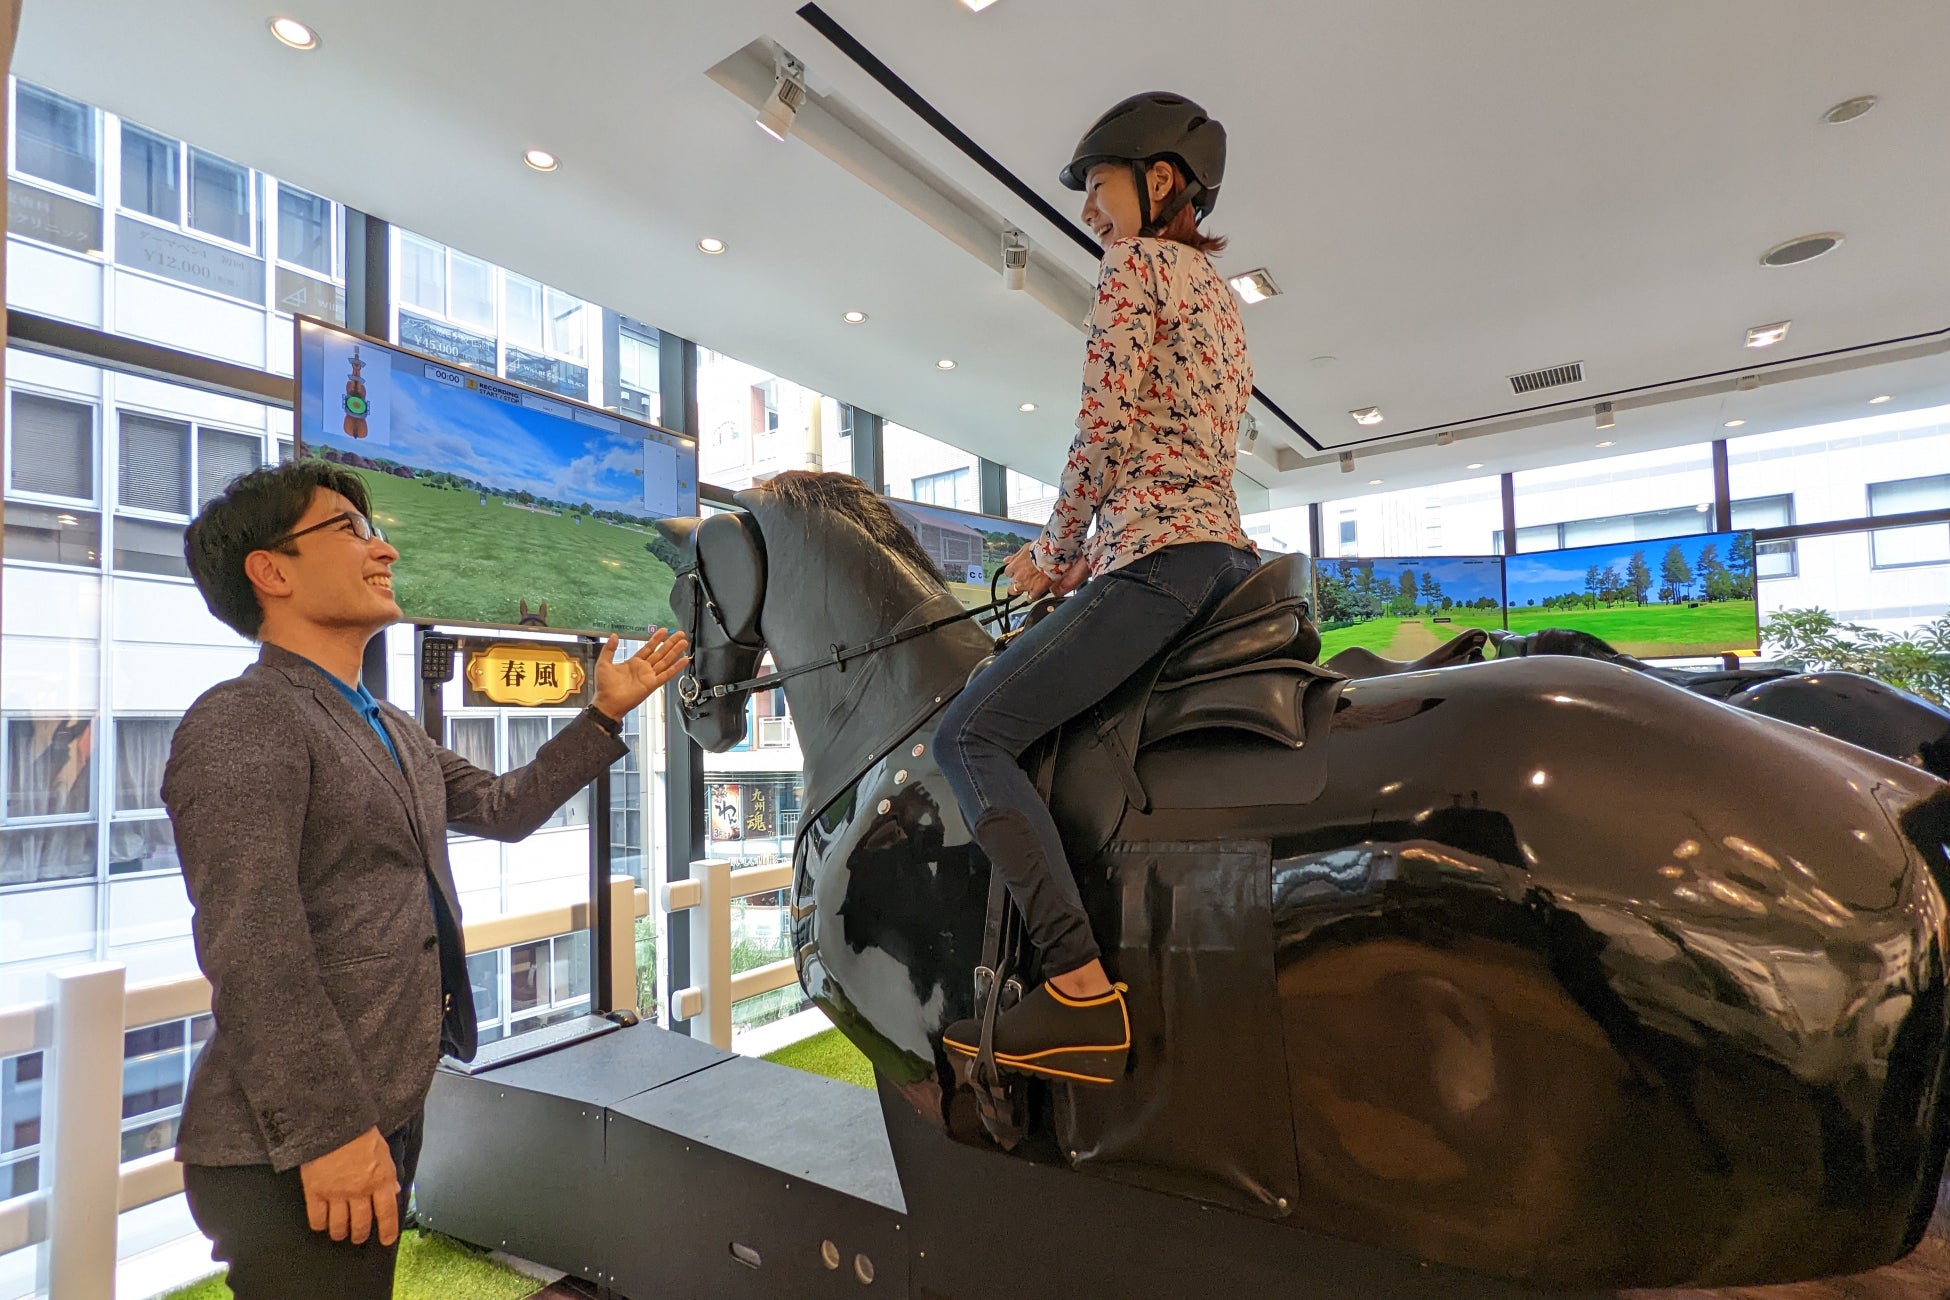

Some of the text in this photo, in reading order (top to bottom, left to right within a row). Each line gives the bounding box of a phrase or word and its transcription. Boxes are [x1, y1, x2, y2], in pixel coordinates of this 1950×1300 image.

[435, 370, 460, 384] 00:00
[479, 383, 519, 399] RECORDING
[479, 389, 499, 400] START
[503, 395, 520, 404] STOP
[500, 660, 559, 688] 春風
[746, 788, 767, 832] 九州魂
